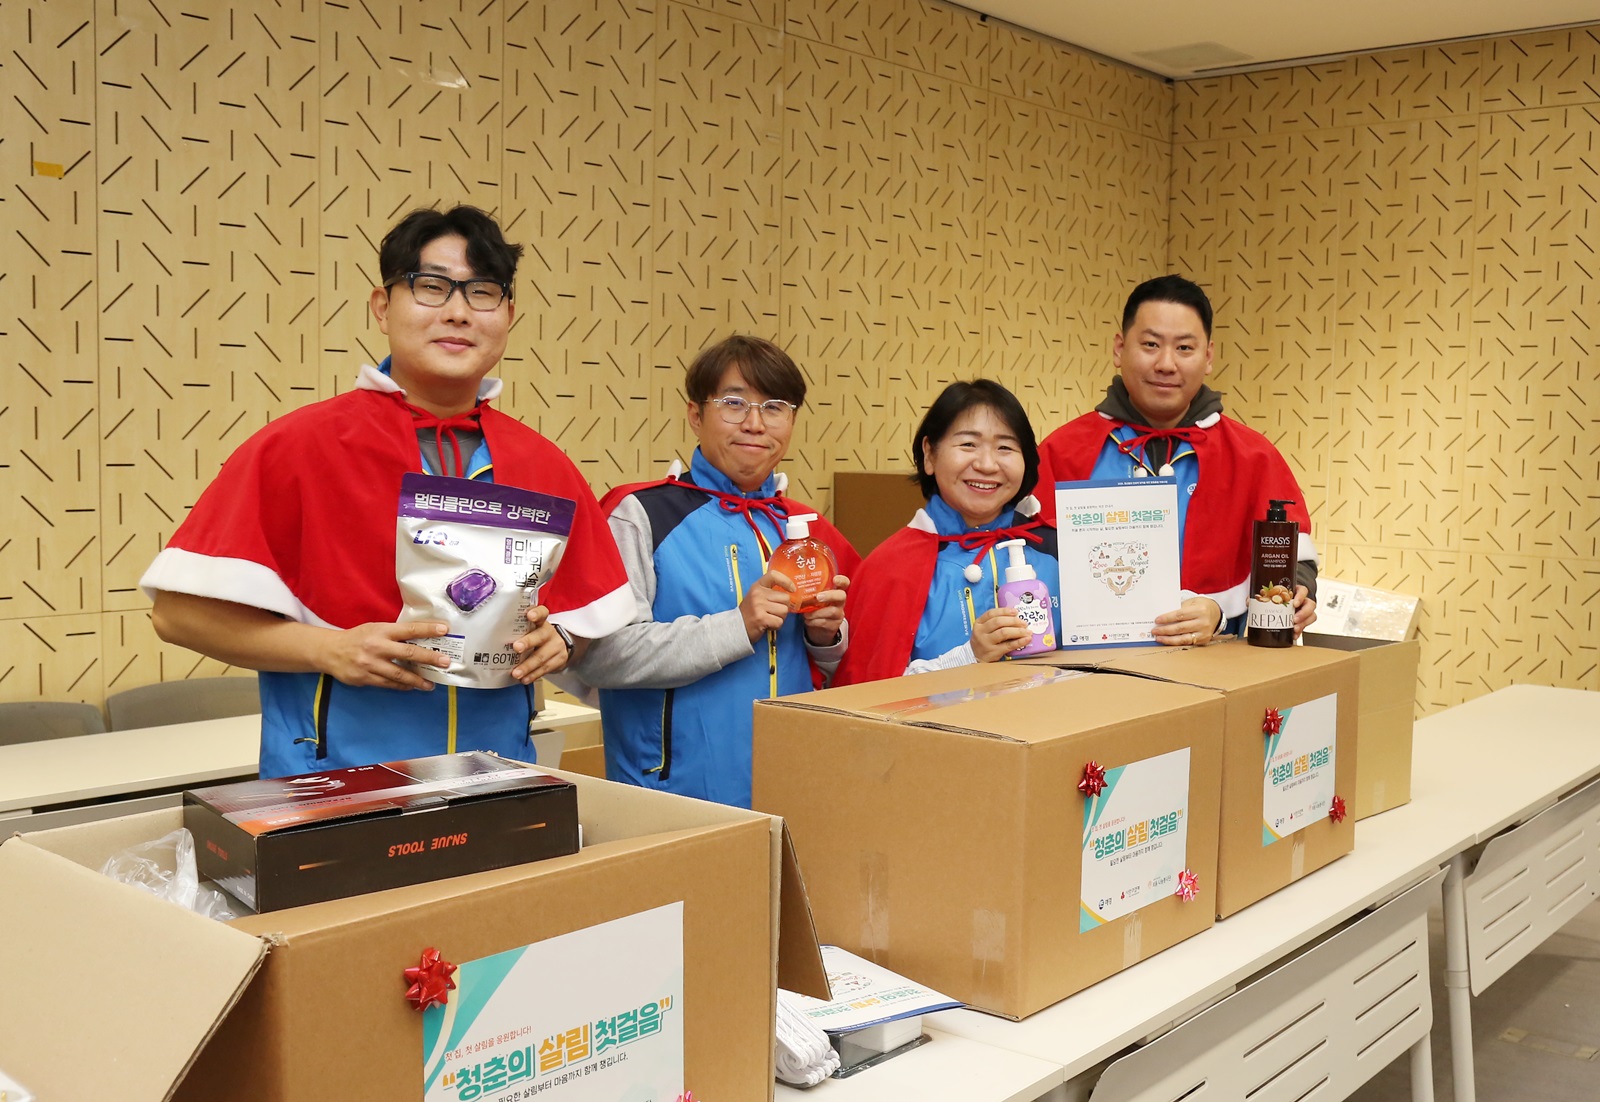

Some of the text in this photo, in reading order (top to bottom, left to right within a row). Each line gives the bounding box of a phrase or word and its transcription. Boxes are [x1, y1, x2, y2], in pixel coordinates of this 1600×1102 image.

[414, 492, 551, 525] 멀티클린으로 강력한
[1106, 511, 1128, 523] 살림
[1260, 536, 1291, 545] KERASYS
[1251, 613, 1293, 627] REPAIR
[1294, 754, 1308, 776] 살림
[388, 832, 468, 857] SNJUE TOOLS
[1127, 820, 1148, 847] 살림
[443, 996, 670, 1102] “청춘의 살림 첫걸음”
[446, 1026, 532, 1061] 첫 집, 첫 살림을 응원합니다!
[523, 1080, 552, 1098] 살림부터
[554, 1069, 582, 1086] 마음까지
[584, 1063, 598, 1076] 함께
[599, 1052, 629, 1070] 챙깁니다.
